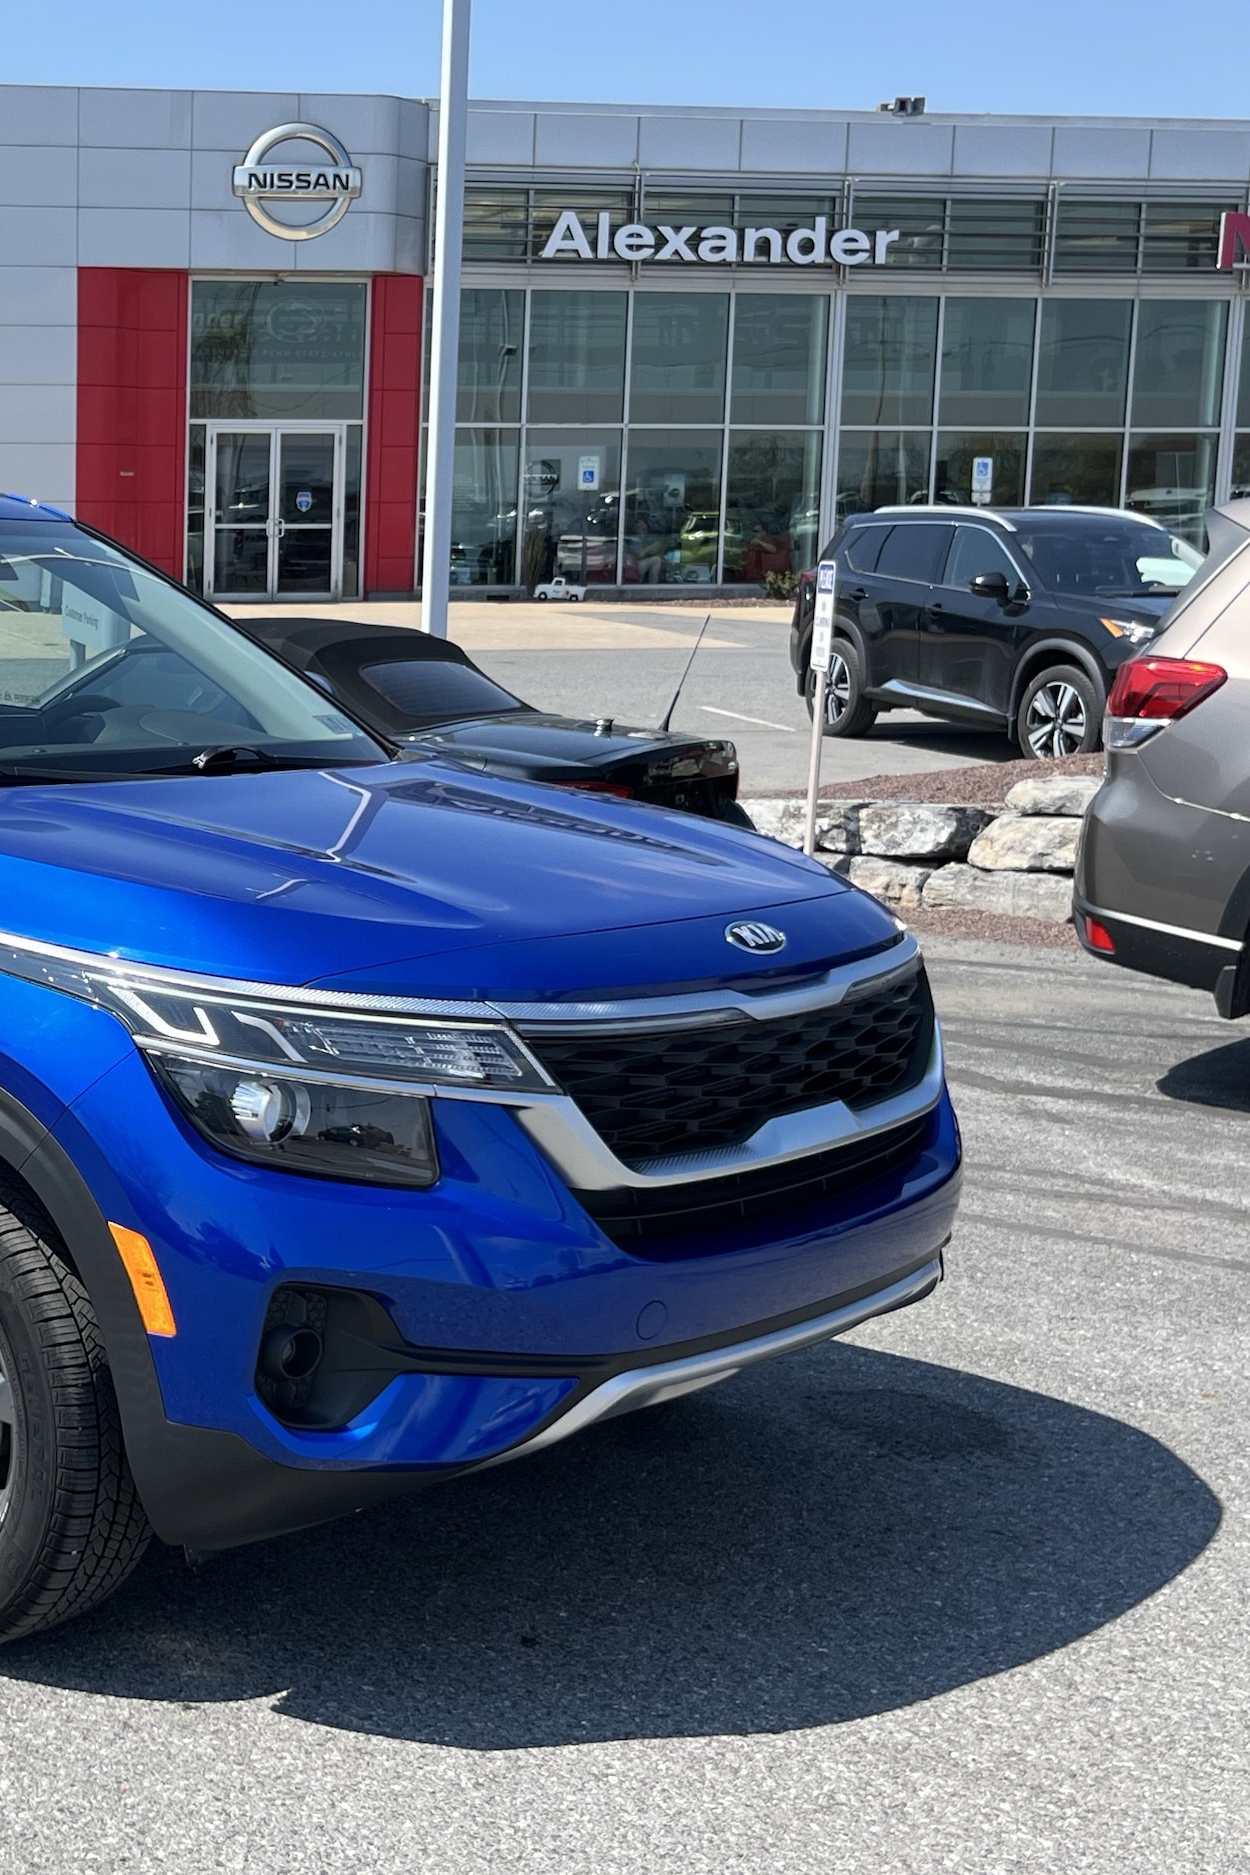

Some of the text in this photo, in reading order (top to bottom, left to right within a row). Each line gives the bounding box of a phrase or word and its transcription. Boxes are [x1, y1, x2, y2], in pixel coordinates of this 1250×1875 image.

[247, 172, 350, 191] NISSAN
[539, 210, 900, 266] Alexander
[732, 923, 782, 947] KIA
